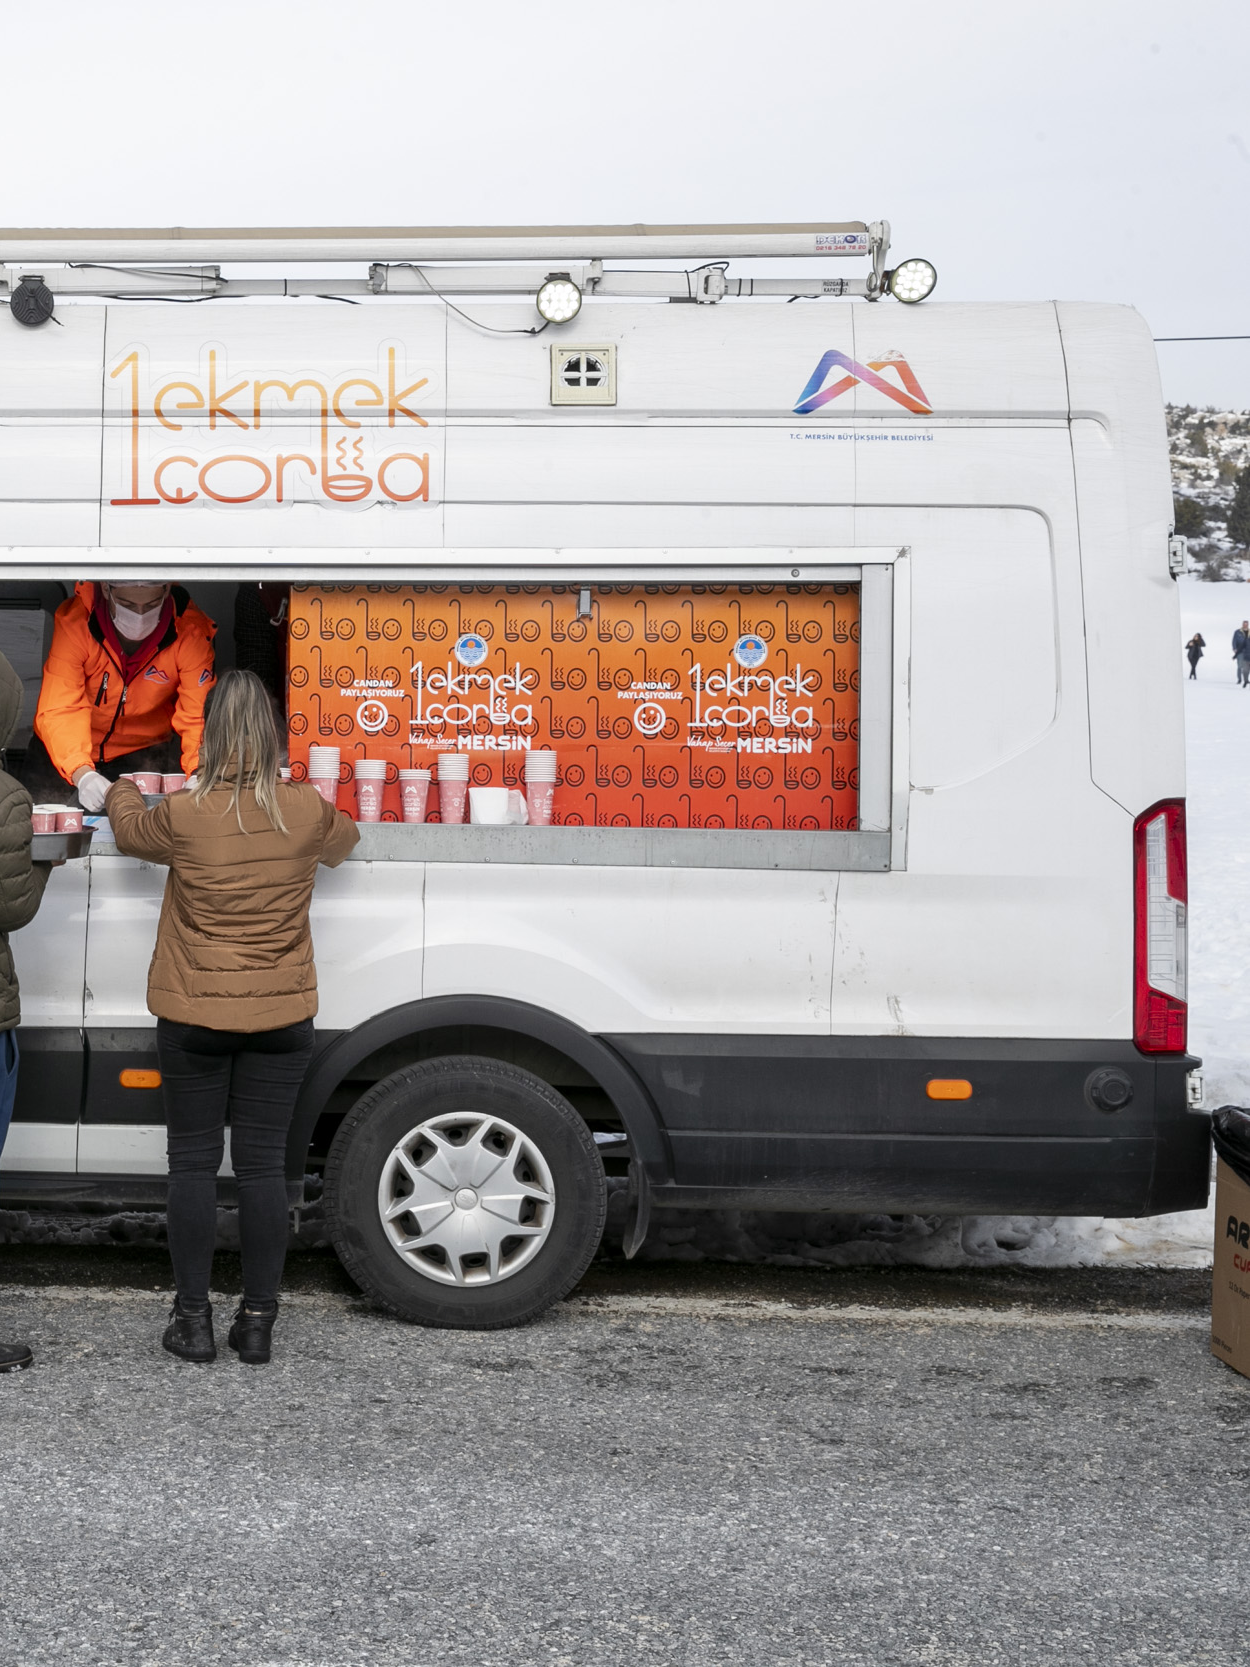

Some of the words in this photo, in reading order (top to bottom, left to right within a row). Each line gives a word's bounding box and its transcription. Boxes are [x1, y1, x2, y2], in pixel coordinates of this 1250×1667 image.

[353, 679, 393, 688] CANDAN
[630, 681, 671, 690] CANDAN
[340, 689, 405, 699] PAYLAŞIYORUZ
[617, 691, 683, 701] PAYLAŞIYORUZ
[409, 732, 435, 750] Vahap
[687, 735, 713, 752] Vahap
